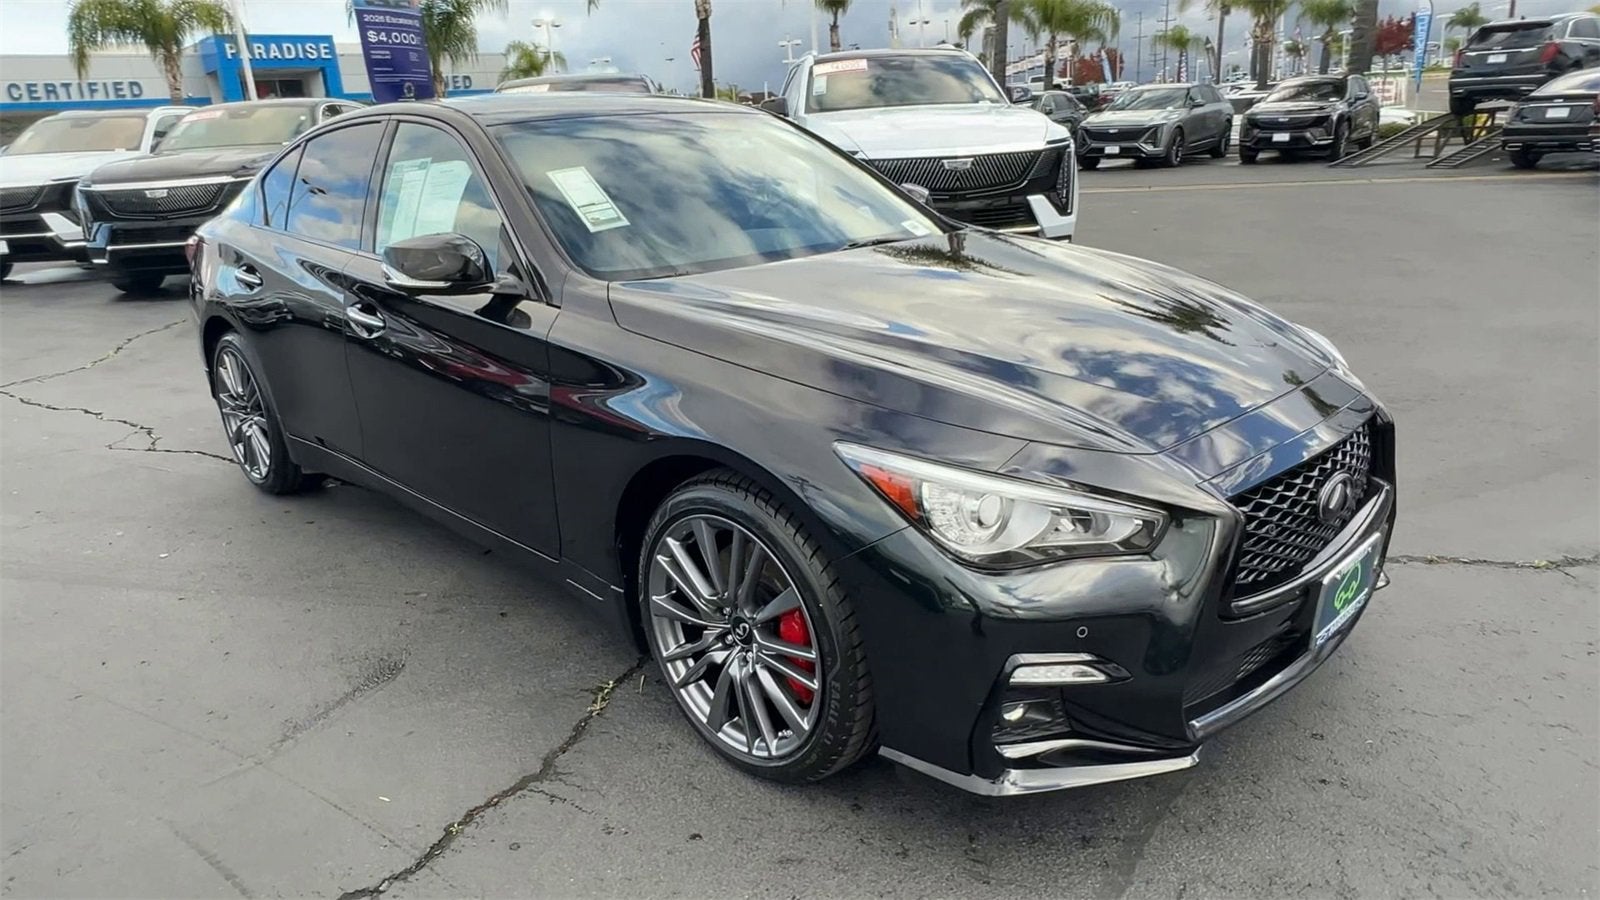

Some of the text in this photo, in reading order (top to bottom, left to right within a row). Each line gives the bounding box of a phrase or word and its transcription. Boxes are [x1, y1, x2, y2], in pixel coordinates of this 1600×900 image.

[367, 30, 416, 44] $4,000
[224, 42, 333, 60] PRADISE
[7, 81, 143, 101] CERTIFIED
